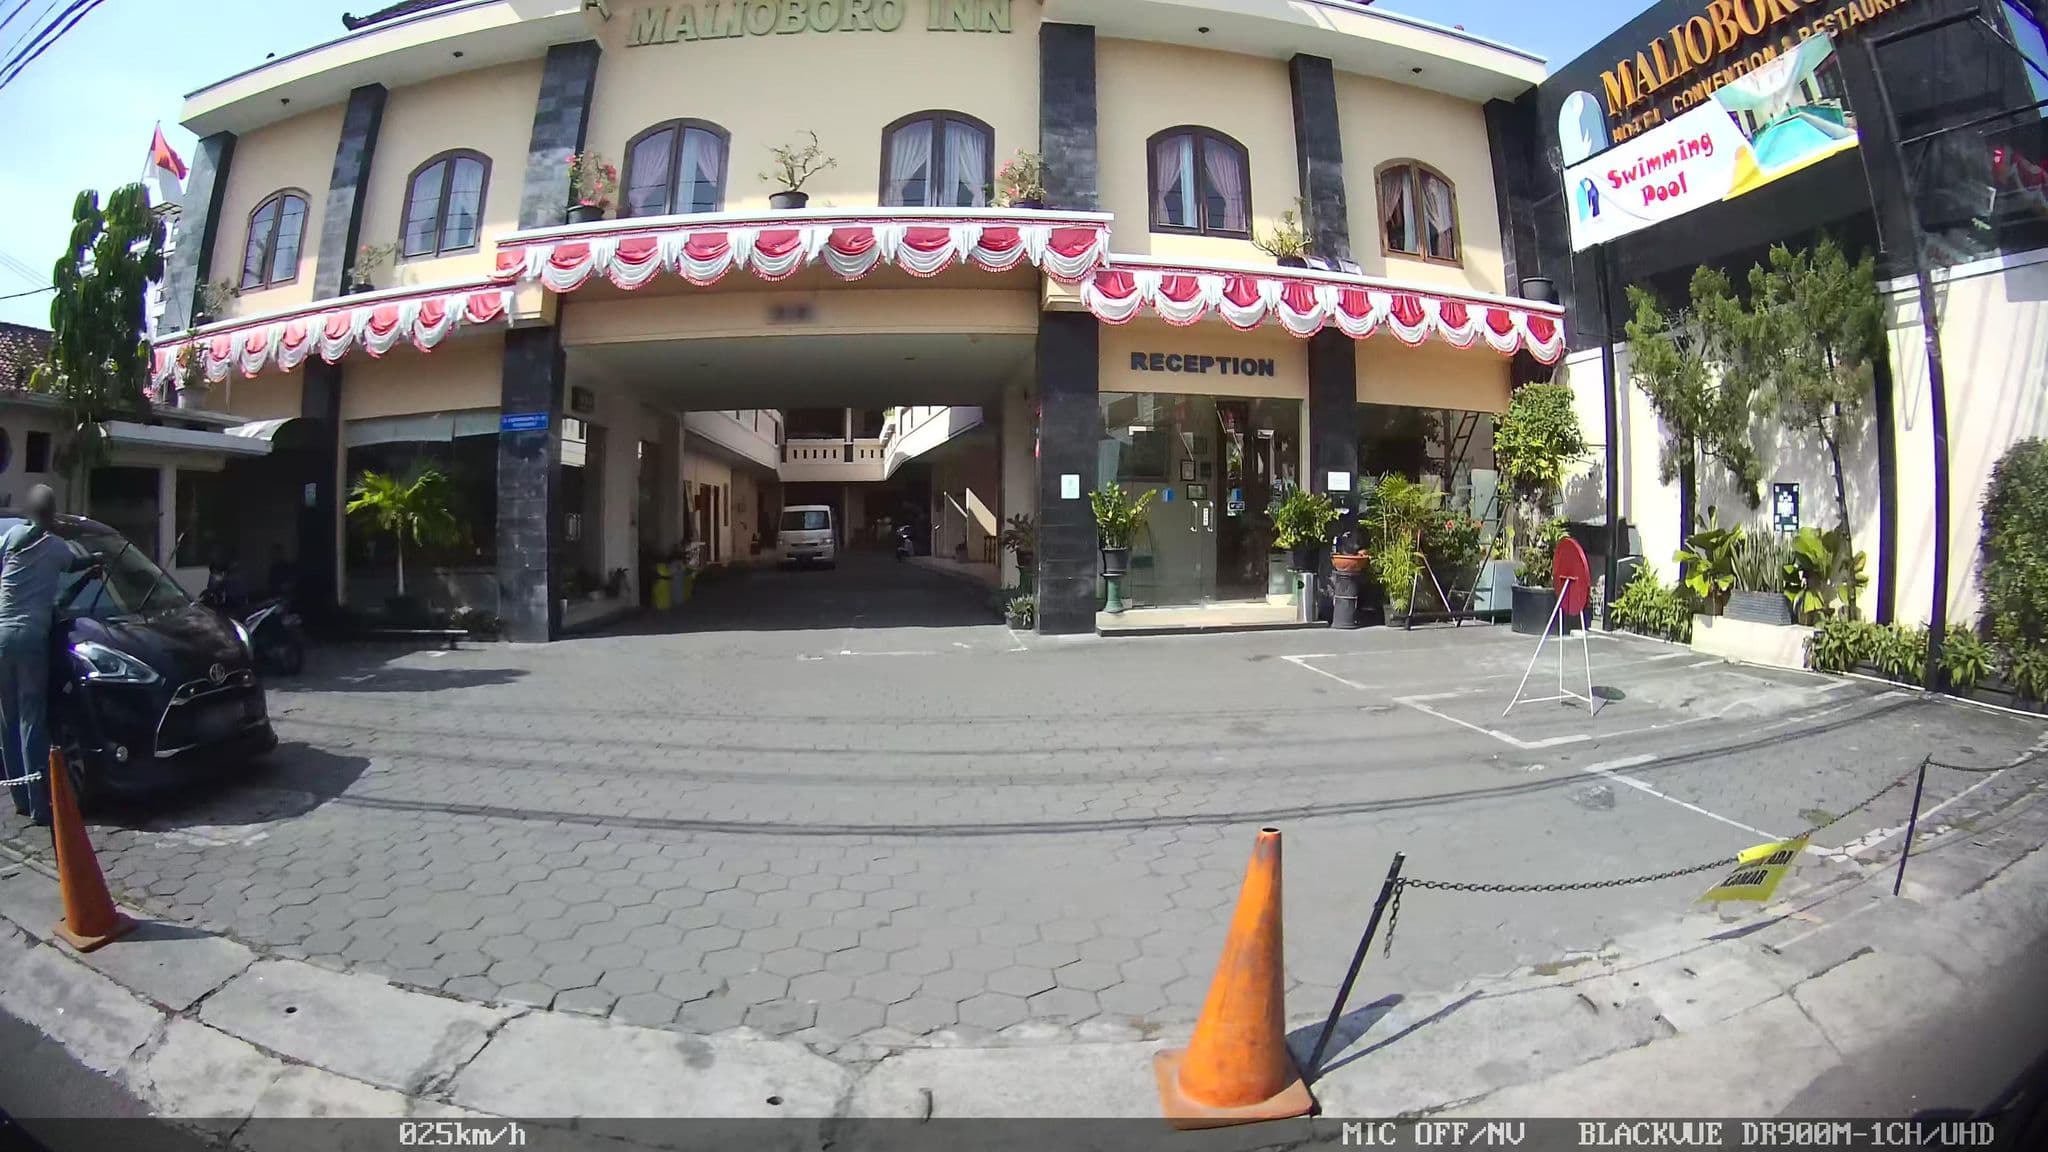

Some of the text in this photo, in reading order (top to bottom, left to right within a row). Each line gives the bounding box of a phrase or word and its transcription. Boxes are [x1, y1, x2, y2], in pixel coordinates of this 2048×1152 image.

[627, 0, 1012, 47] MALIOBORO INN
[1671, 44, 1778, 114] CONVENTION
[1607, 132, 1714, 189] Swimming
[1130, 351, 1275, 377] RECEPTION
